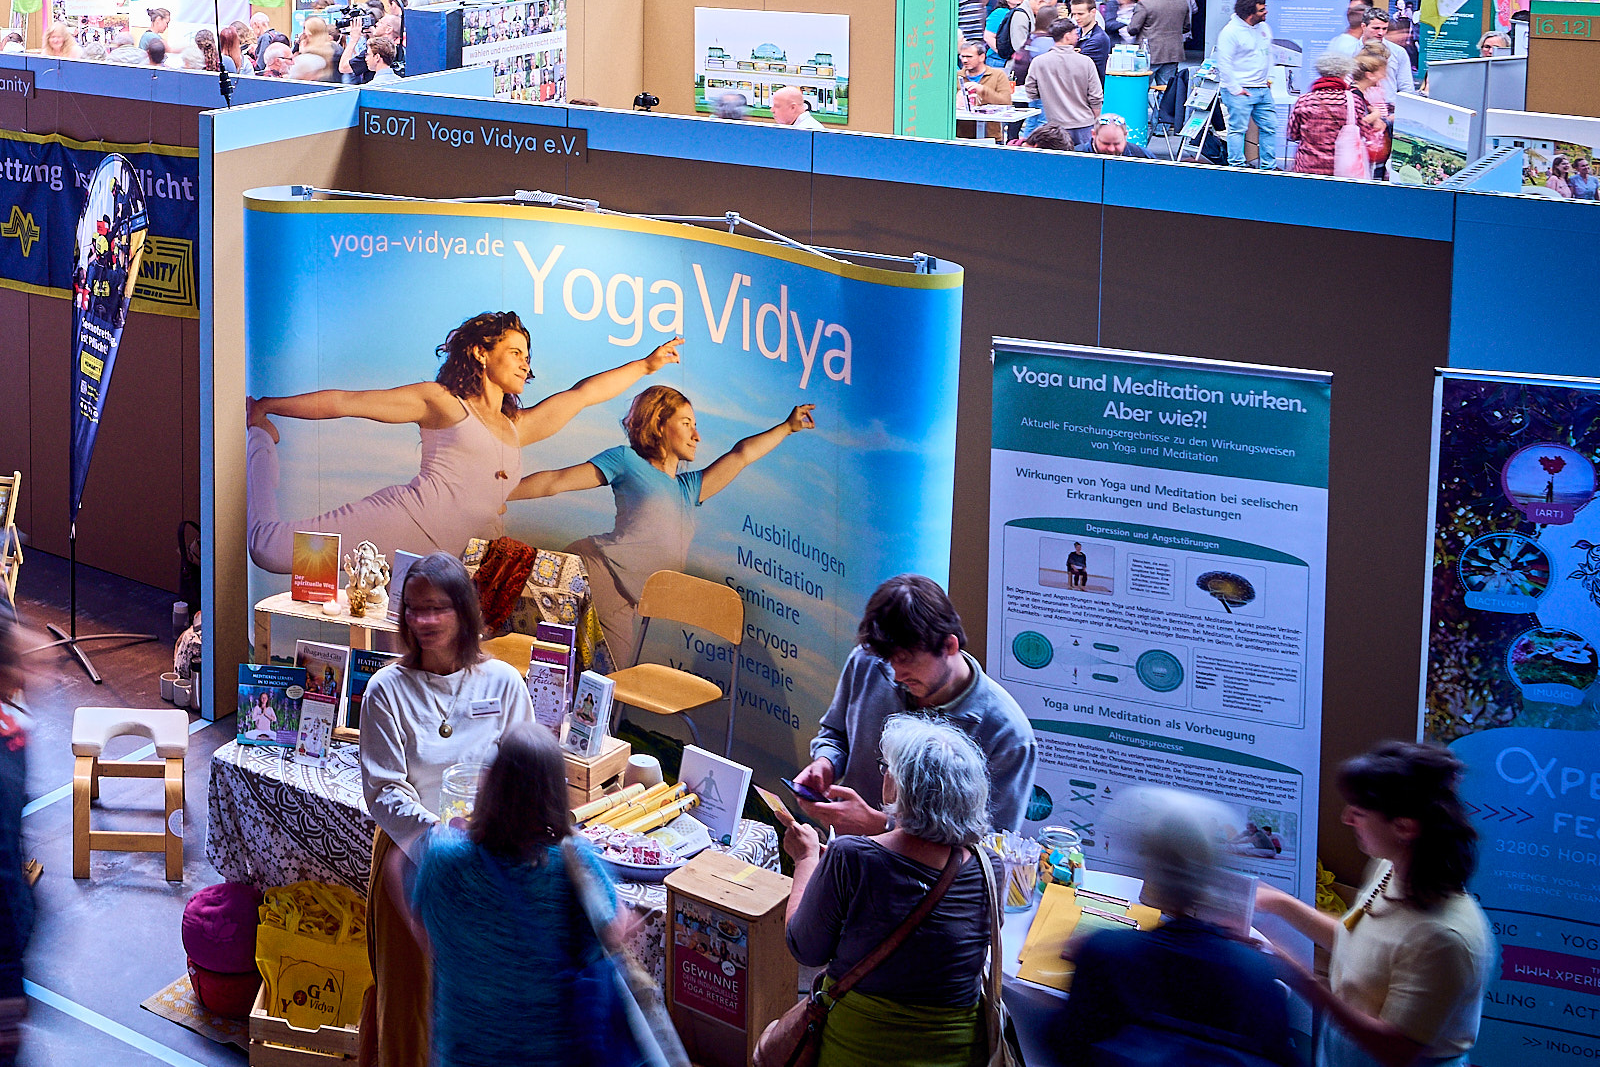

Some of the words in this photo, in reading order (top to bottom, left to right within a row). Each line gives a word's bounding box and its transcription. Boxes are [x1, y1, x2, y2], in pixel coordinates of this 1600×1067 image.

[1535, 16, 1592, 38] [6.12]
[363, 112, 416, 140] [5.07]
[427, 119, 475, 148] Yoga
[480, 126, 538, 154] Vidya
[543, 133, 581, 156] e.V.
[329, 230, 505, 260] yoga-vidya.de
[512, 239, 685, 346] Yoga
[693, 263, 853, 390] Vidya
[1012, 365, 1063, 388] Yoga
[1068, 374, 1107, 392] und
[1113, 375, 1224, 404] Meditation
[1230, 390, 1308, 414] wirken.
[1103, 400, 1153, 423] Aber
[1158, 409, 1208, 429] wie?!
[1020, 416, 1060, 431] Aktuelle
[1063, 421, 1170, 443] Forschungsergebnisse
[1173, 436, 1186, 445] zu
[1188, 436, 1208, 447] den
[1211, 438, 1296, 458] Wirkungsweisen
[1090, 441, 1109, 450] von
[1112, 441, 1137, 454] Yoga
[1140, 446, 1160, 457] und
[1162, 447, 1219, 463] Meditation
[1015, 466, 1074, 487] Wirkungen
[1076, 475, 1097, 487] von
[1100, 476, 1127, 494] Yoga
[1130, 481, 1151, 494] und
[1154, 484, 1217, 502] Meditation
[1220, 491, 1238, 505] bei
[1241, 493, 1299, 512] seelischen
[1066, 489, 1143, 509] Erkrankungen
[1146, 498, 1169, 512] und
[1172, 501, 1242, 522] Belastungen
[742, 514, 847, 578] Ausbildungen
[1085, 522, 1130, 539] Depression
[1132, 529, 1150, 540] und
[1151, 530, 1220, 550] Angststörungen
[294, 580, 322, 588] spirituelle
[322, 581, 335, 590] Weg
[737, 545, 825, 602] Meditation
[725, 576, 801, 625] Seminare
[1042, 697, 1069, 714] Yoga
[1073, 701, 1094, 716] und
[1098, 705, 1162, 728] Meditation
[1165, 717, 1182, 731] als
[1184, 720, 1257, 745] Vorbeugung
[1108, 731, 1185, 753] Alterungsprozesse
[1496, 839, 1550, 858] 32805
[682, 960, 739, 994] GEWINNE
[309, 999, 335, 1014] Vidya
[683, 981, 704, 995] YOGA
[706, 991, 739, 1010] RETREAT
